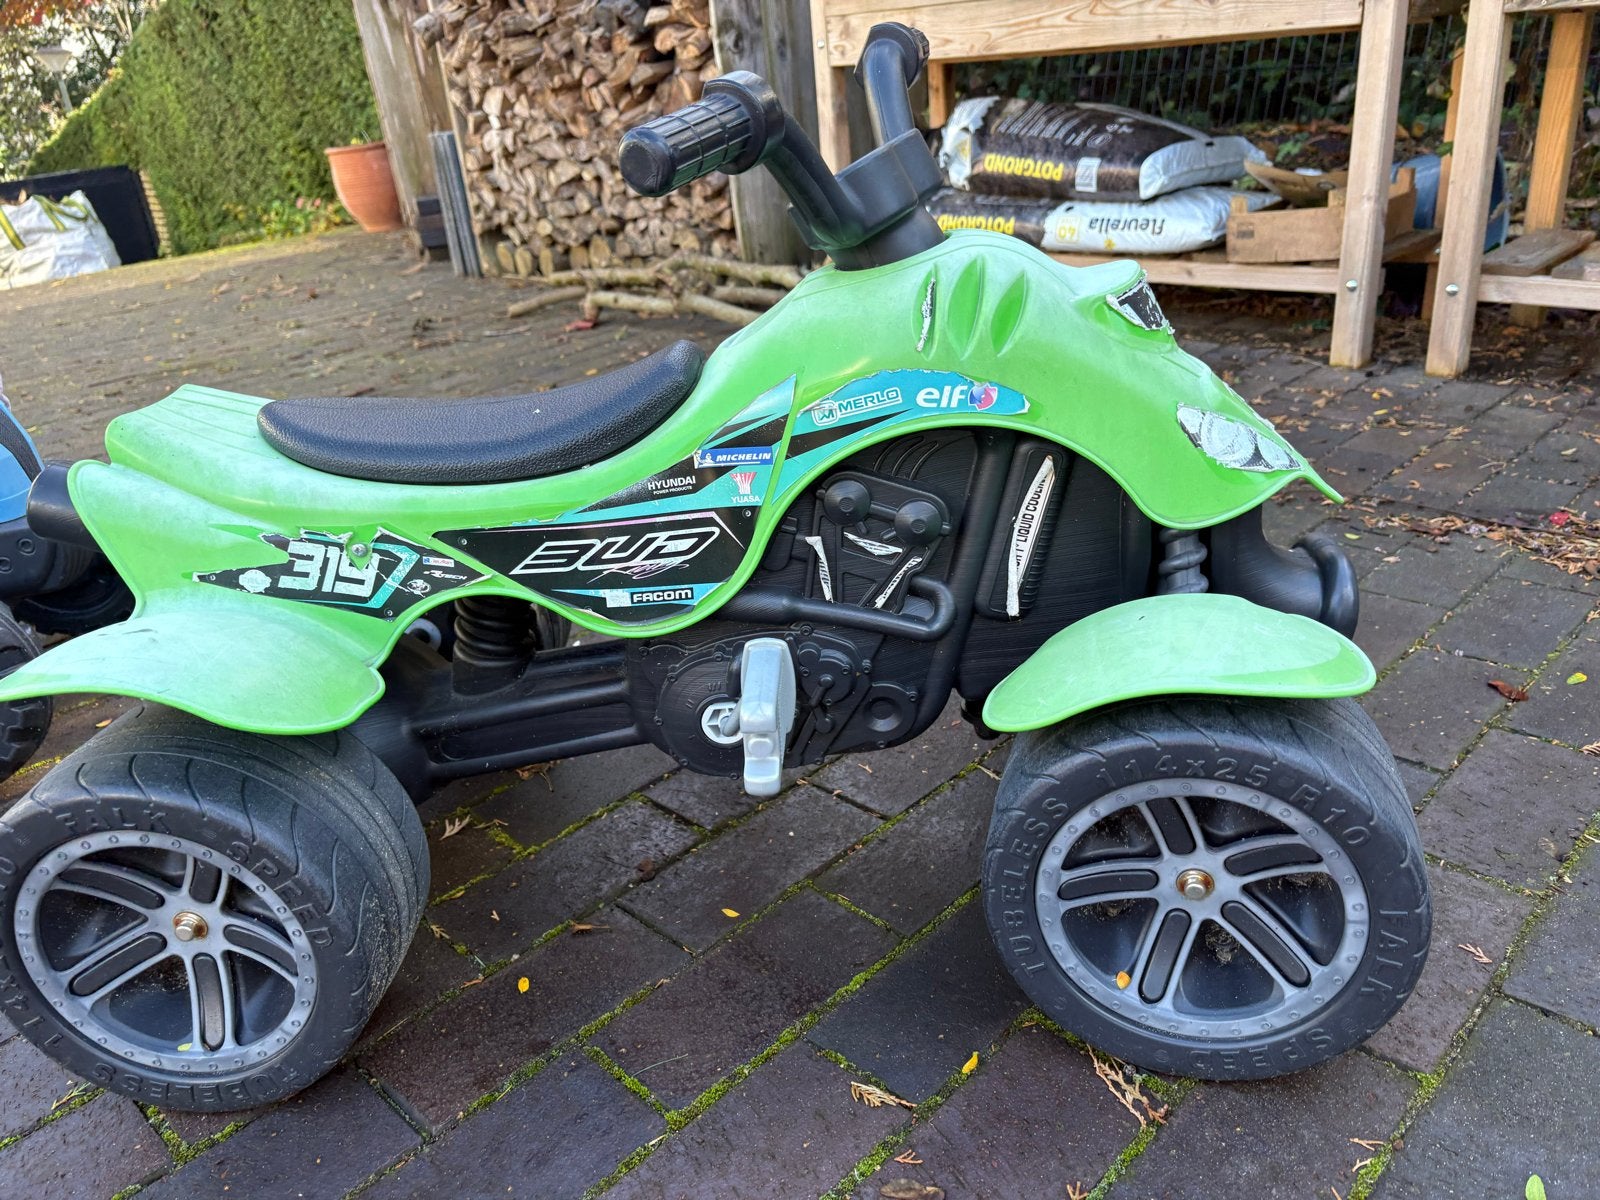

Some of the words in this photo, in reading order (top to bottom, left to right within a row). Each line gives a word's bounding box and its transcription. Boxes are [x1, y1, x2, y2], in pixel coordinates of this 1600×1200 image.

[984, 153, 1064, 182] POTGROND
[1057, 224, 1076, 240] 40
[1089, 217, 1166, 236] fleurella
[838, 388, 901, 411] MERLO
[915, 384, 969, 409] elf
[716, 452, 772, 463] MICHELIN
[647, 475, 696, 491] HYUNDAI
[653, 488, 669, 496] POWER
[669, 485, 693, 493] PRODUCTS
[731, 496, 760, 504] YUASA
[1016, 513, 1035, 543] LIQUID
[508, 526, 721, 576] BUD
[278, 540, 380, 597] 319
[632, 589, 693, 603] FACOM
[56, 806, 170, 837] FALK
[226, 841, 333, 948] SPEED
[1001, 796, 1070, 977] TUBELESS
[1361, 908, 1411, 994] FALK
[1188, 1027, 1333, 1070] SPEED
